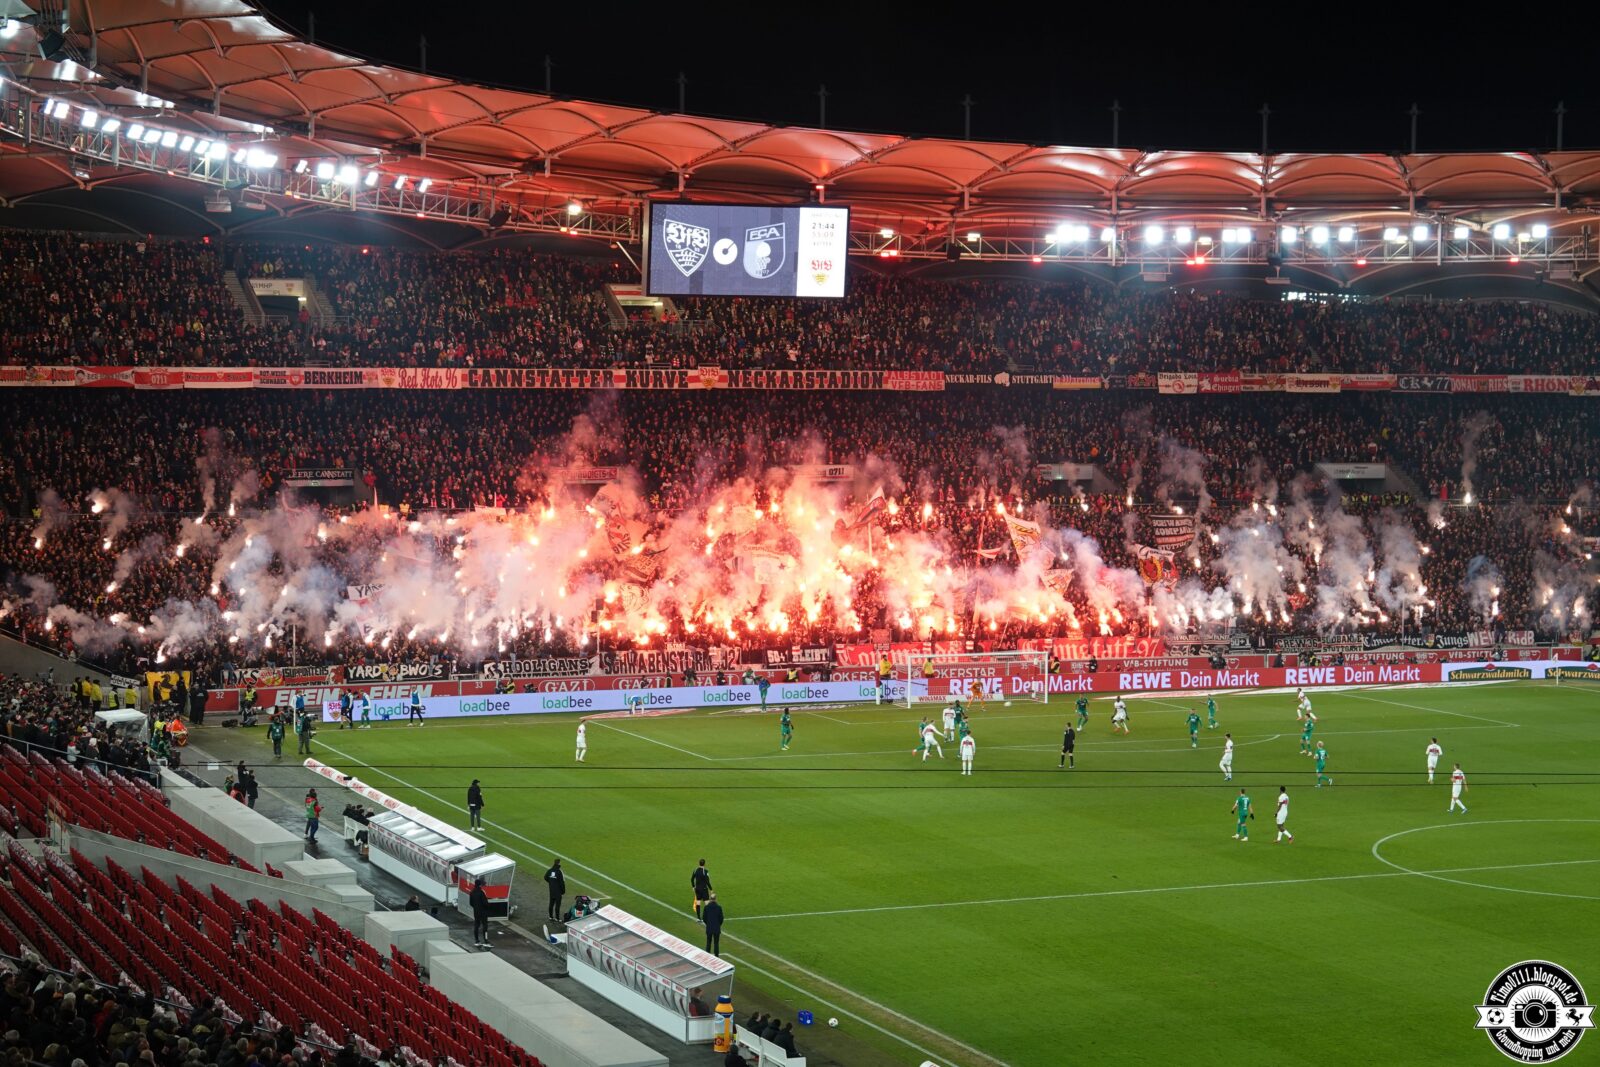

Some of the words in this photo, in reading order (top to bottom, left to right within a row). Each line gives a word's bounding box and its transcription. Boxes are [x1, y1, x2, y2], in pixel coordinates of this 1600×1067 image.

[750, 227, 780, 240] FCA
[304, 371, 363, 385] BERKHEIM
[398, 368, 417, 388] Red
[420, 368, 443, 389] Hots
[445, 369, 458, 388] 96
[468, 369, 614, 388] CANNSTATTER
[625, 370, 689, 388] KURVE
[728, 370, 884, 389] NECKARSTADION
[890, 371, 944, 380] ALBSTADT
[945, 374, 992, 384] NECKAR-FILS
[1012, 374, 1054, 384] STUTTGART
[891, 380, 943, 390] VFB-FANS
[1451, 377, 1478, 391] DONAU
[1488, 377, 1508, 391] RIES
[1345, 653, 1405, 661] VfB-STIFTUNG
[1449, 650, 1508, 659] VfB-STIFTUG
[502, 659, 589, 674] HOOLIGANS
[1123, 659, 1188, 667] VfB-STIFTUNG
[348, 666, 381, 679] YARD
[400, 664, 443, 677] BWOS
[829, 670, 898, 682] JOKERSR
[1286, 667, 1336, 684] REWE
[1344, 666, 1374, 683] Dein
[1379, 665, 1421, 682] Markt
[1450, 669, 1529, 680] Schwarzwaldmilch
[1049, 675, 1093, 692] Markt
[1119, 671, 1172, 689] REWE
[1180, 671, 1212, 688] Dein
[1216, 669, 1260, 687] Markt
[215, 691, 225, 699] 32
[370, 684, 433, 699] EHEM
[703, 689, 751, 702] loadbee
[782, 687, 829, 699] loadbee
[542, 696, 592, 709] loadbee
[624, 693, 672, 705] lodbee
[374, 702, 426, 716] loadbe
[459, 699, 510, 713] loadbee
